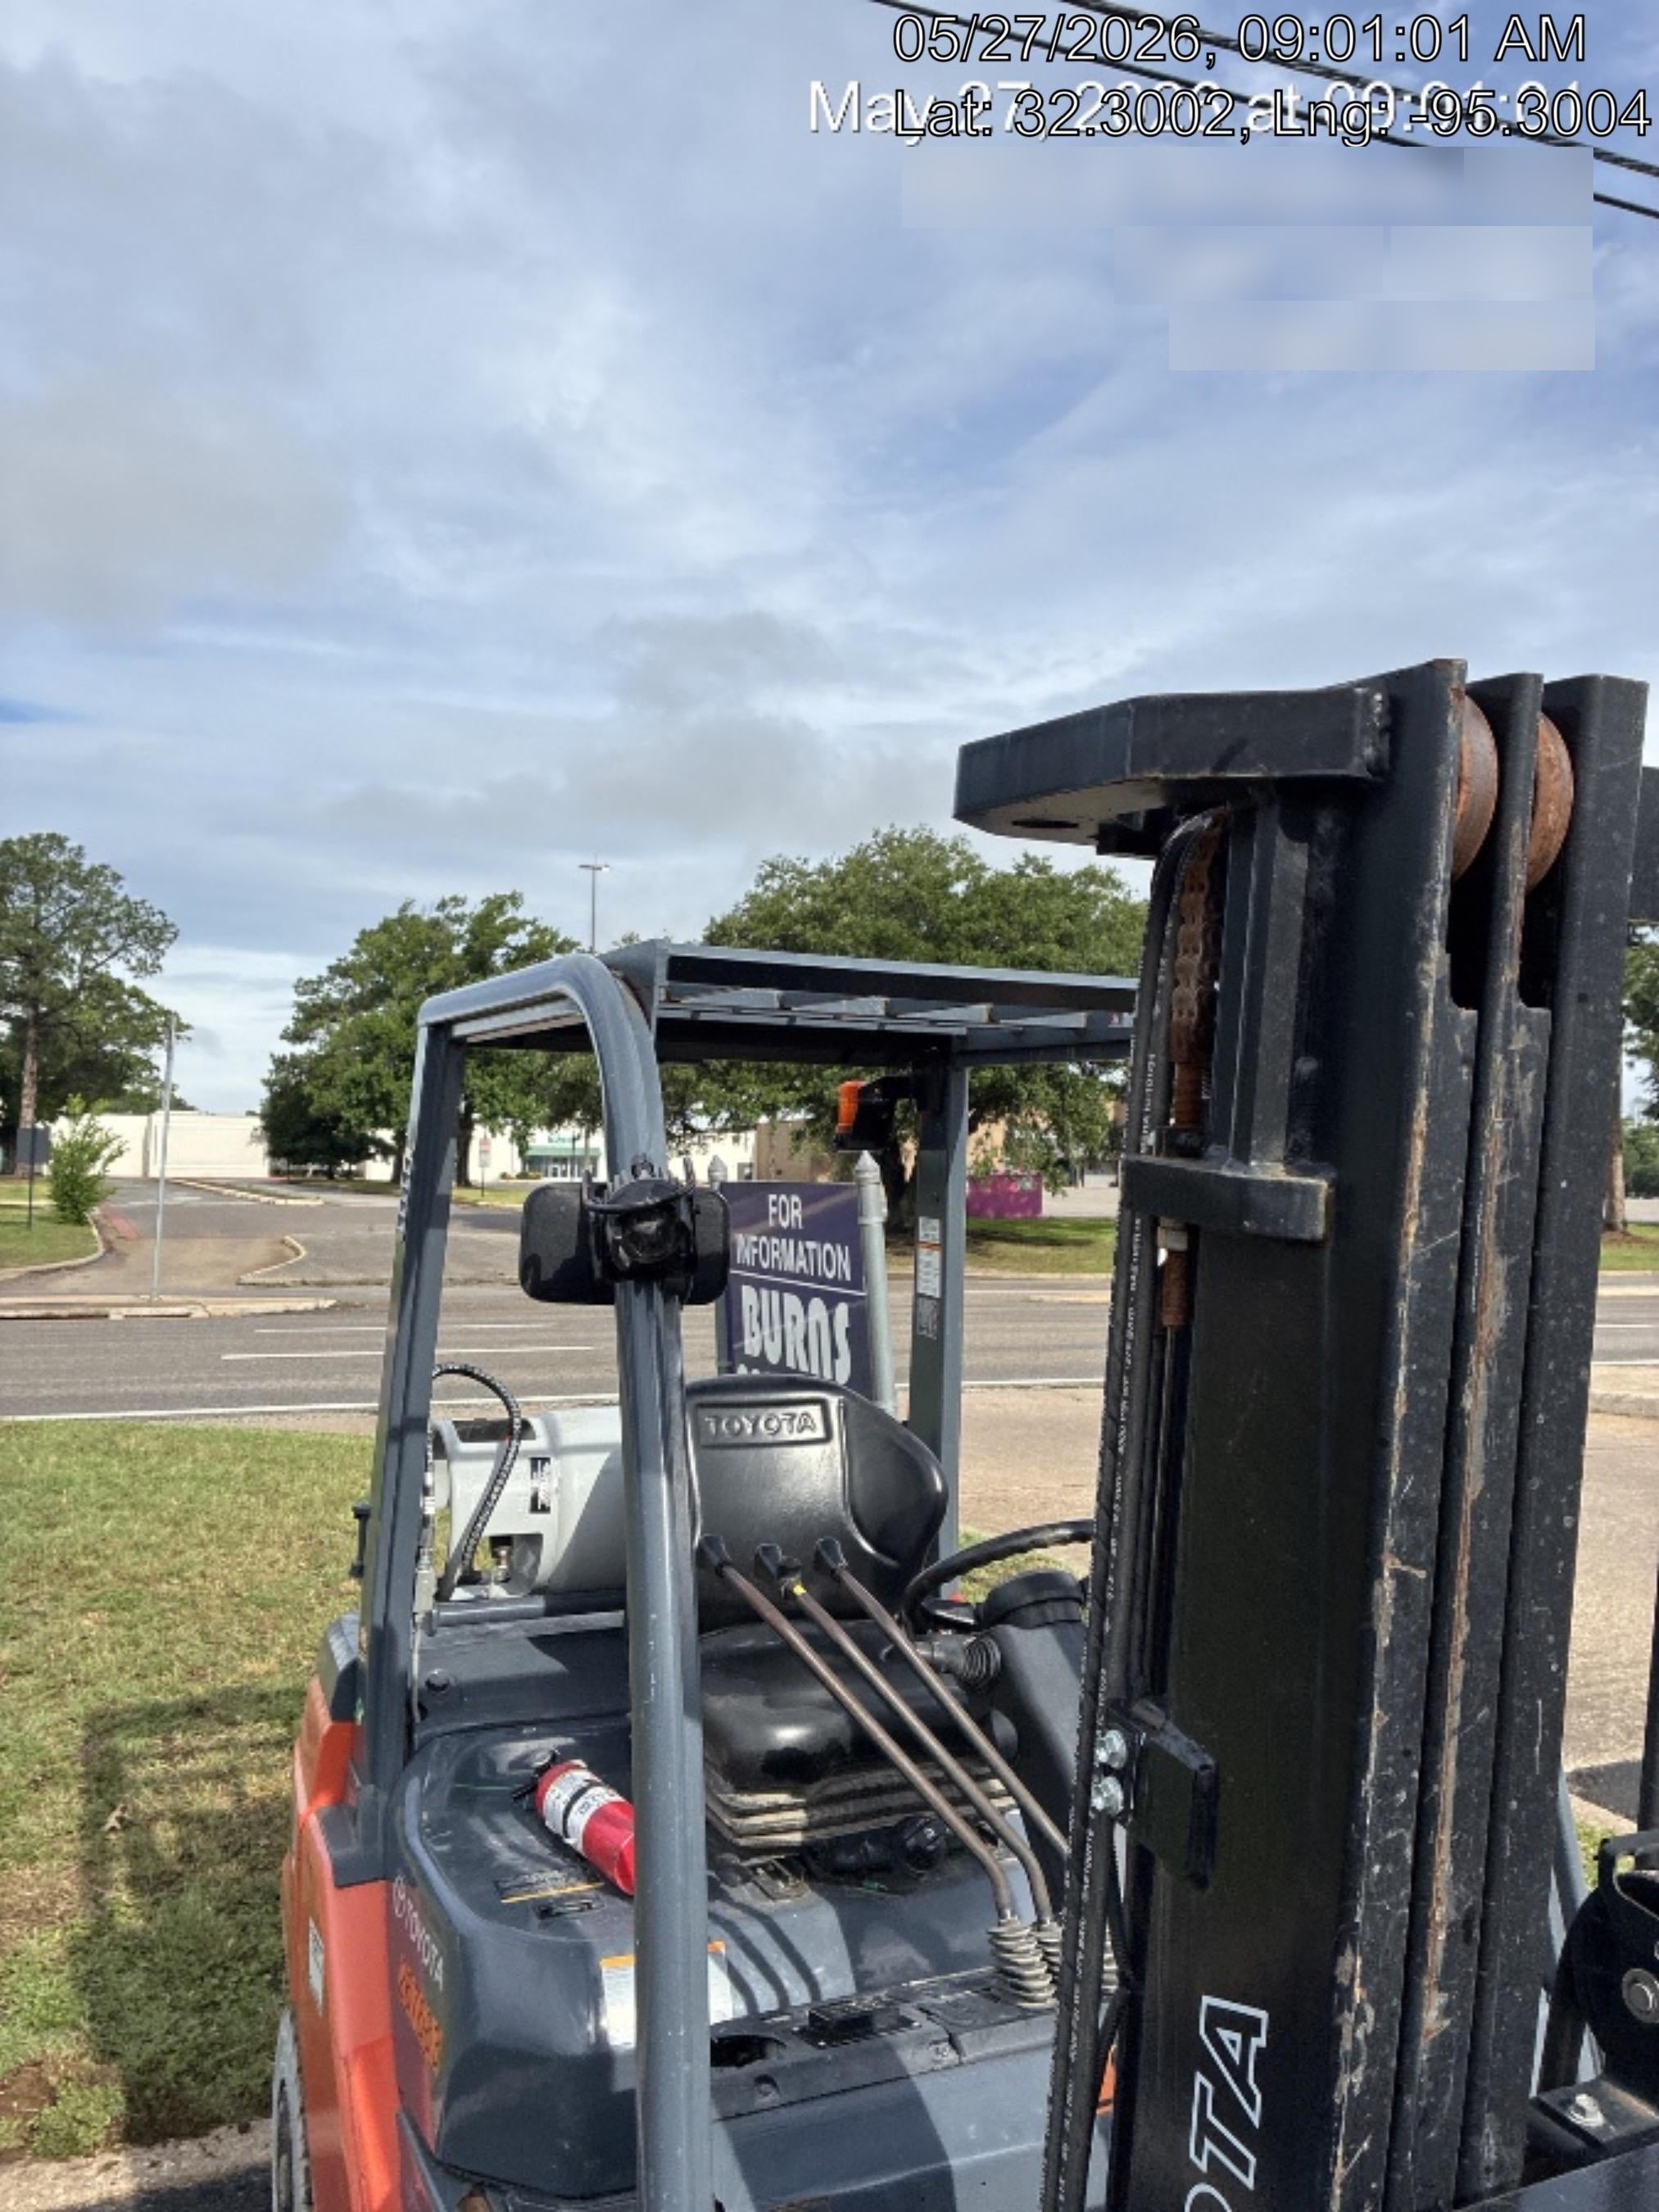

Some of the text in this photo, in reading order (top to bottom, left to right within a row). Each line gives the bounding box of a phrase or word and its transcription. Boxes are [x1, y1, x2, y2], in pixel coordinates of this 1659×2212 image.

[768, 1194, 804, 1230] FOR
[735, 1233, 852, 1282] INFORMATION
[704, 1411, 818, 1437] TOYOTA
[1184, 1994, 1269, 2212] TA
